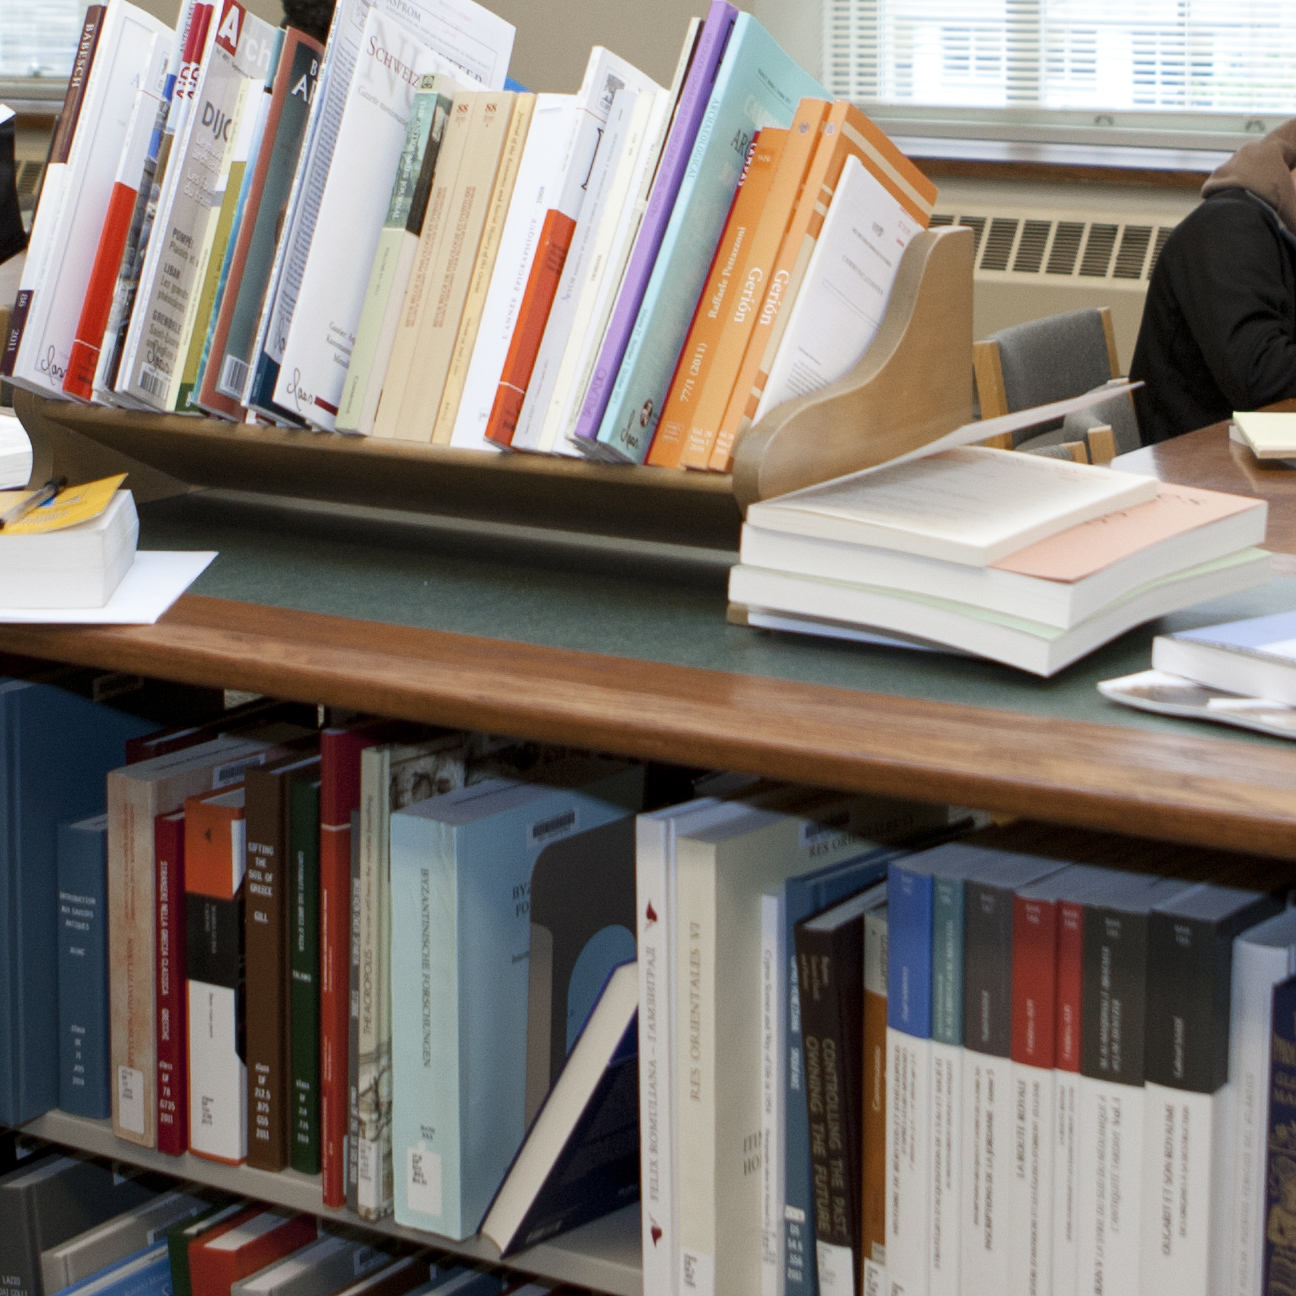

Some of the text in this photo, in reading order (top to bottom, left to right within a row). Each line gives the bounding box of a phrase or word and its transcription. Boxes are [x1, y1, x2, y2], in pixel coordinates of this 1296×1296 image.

[71, 22, 95, 89] BABESCH
[414, 98, 428, 118] THE
[685, 96, 720, 181] ARCHAEOLOGICAL
[390, 179, 409, 222] JOURNAL
[689, 342, 709, 377] (2011)
[707, 280, 729, 320] Raffaele
[721, 225, 747, 278] Pettazzoni
[733, 266, 764, 323] Gerión
[759, 269, 790, 326] Gerión
[5, 326, 20, 353] 2011
[249, 882, 274, 898] GREECE
[255, 856, 268, 869] THE
[418, 867, 433, 1068] BYZANTINISCHE FORSCHUNGEN
[688, 920, 701, 1102] RES ORIENTALES VI
[647, 1058, 659, 1154] ROMULIANA
[805, 1034, 830, 1232] OWNING THE FUTURE
[820, 1036, 845, 1190] CONTROLLING THE
[648, 1157, 659, 1204] FELIX
